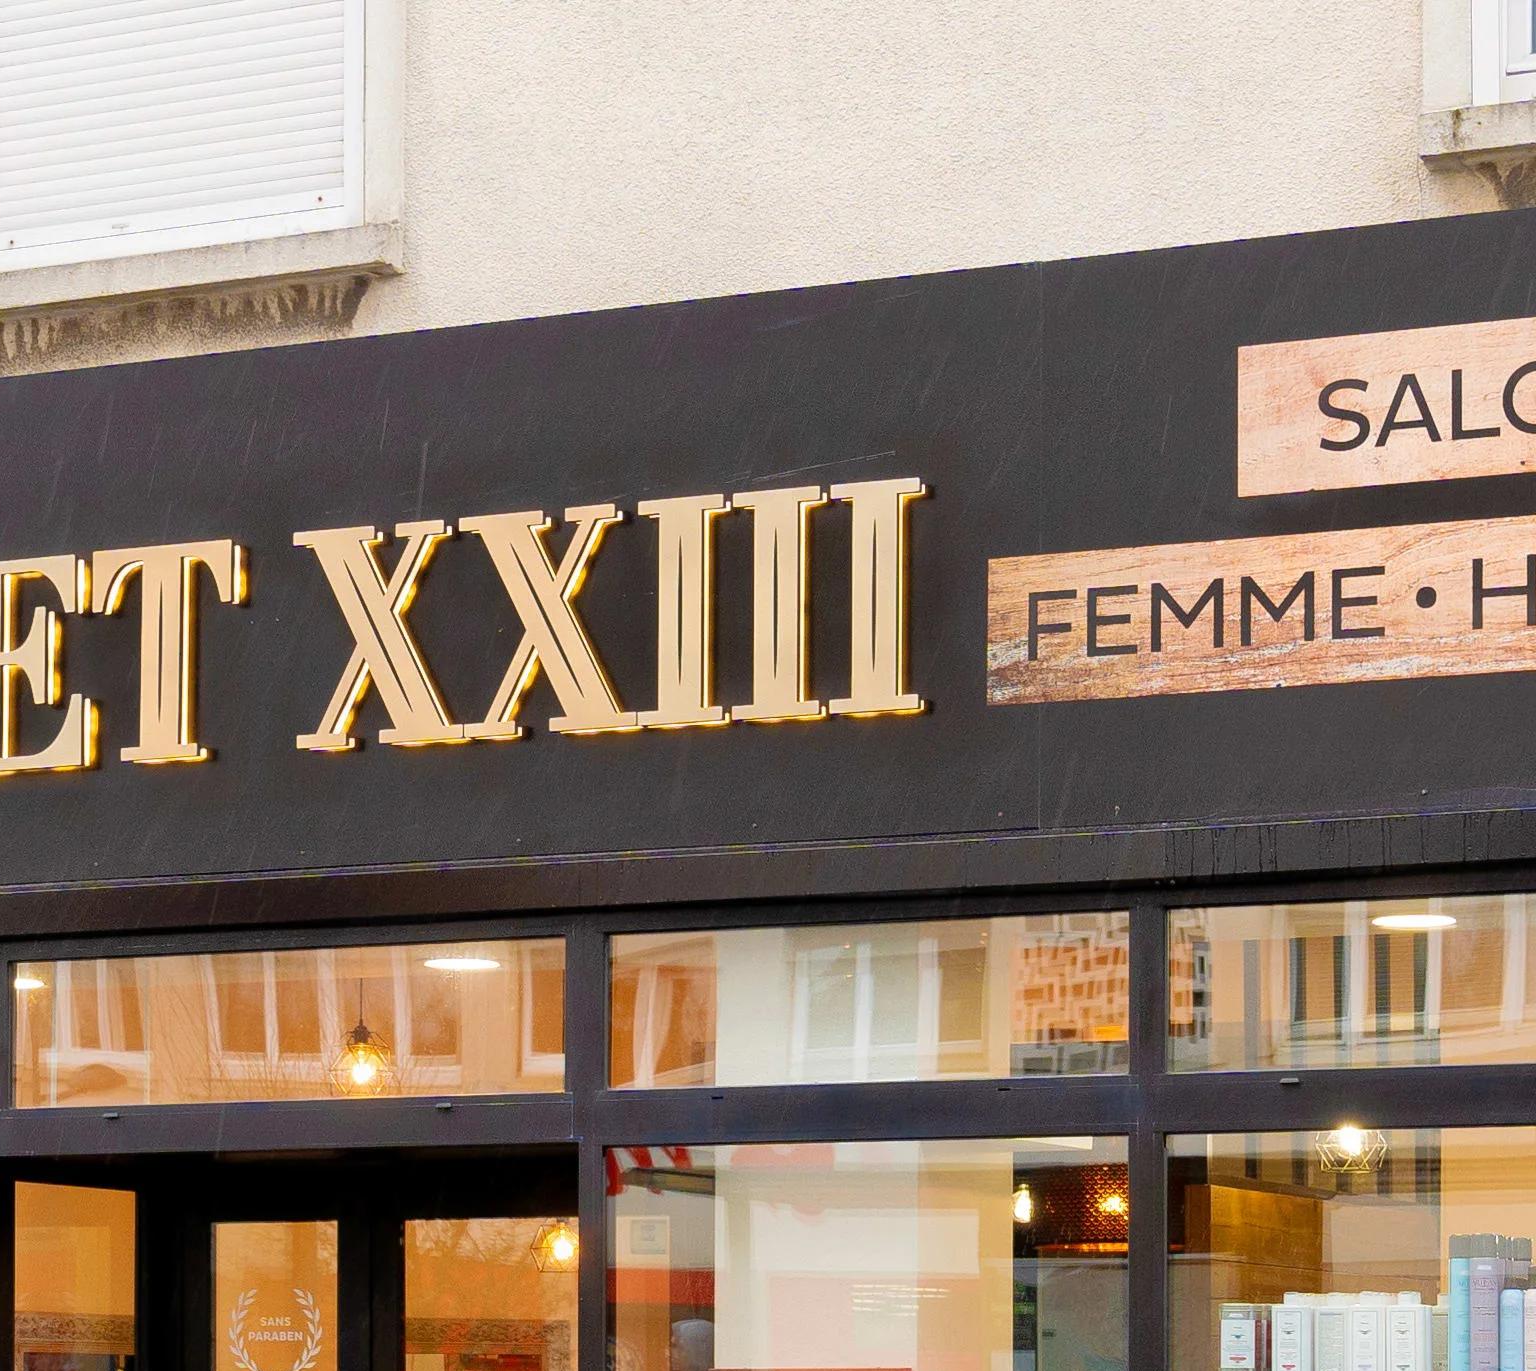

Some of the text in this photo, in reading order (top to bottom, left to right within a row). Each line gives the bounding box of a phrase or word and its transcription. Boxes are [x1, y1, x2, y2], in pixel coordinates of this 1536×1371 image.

[292, 477, 928, 752] XXIII
[1027, 564, 1387, 661] FEMME
[248, 1330, 304, 1342] PARABEN
[259, 1316, 292, 1327] SANS
